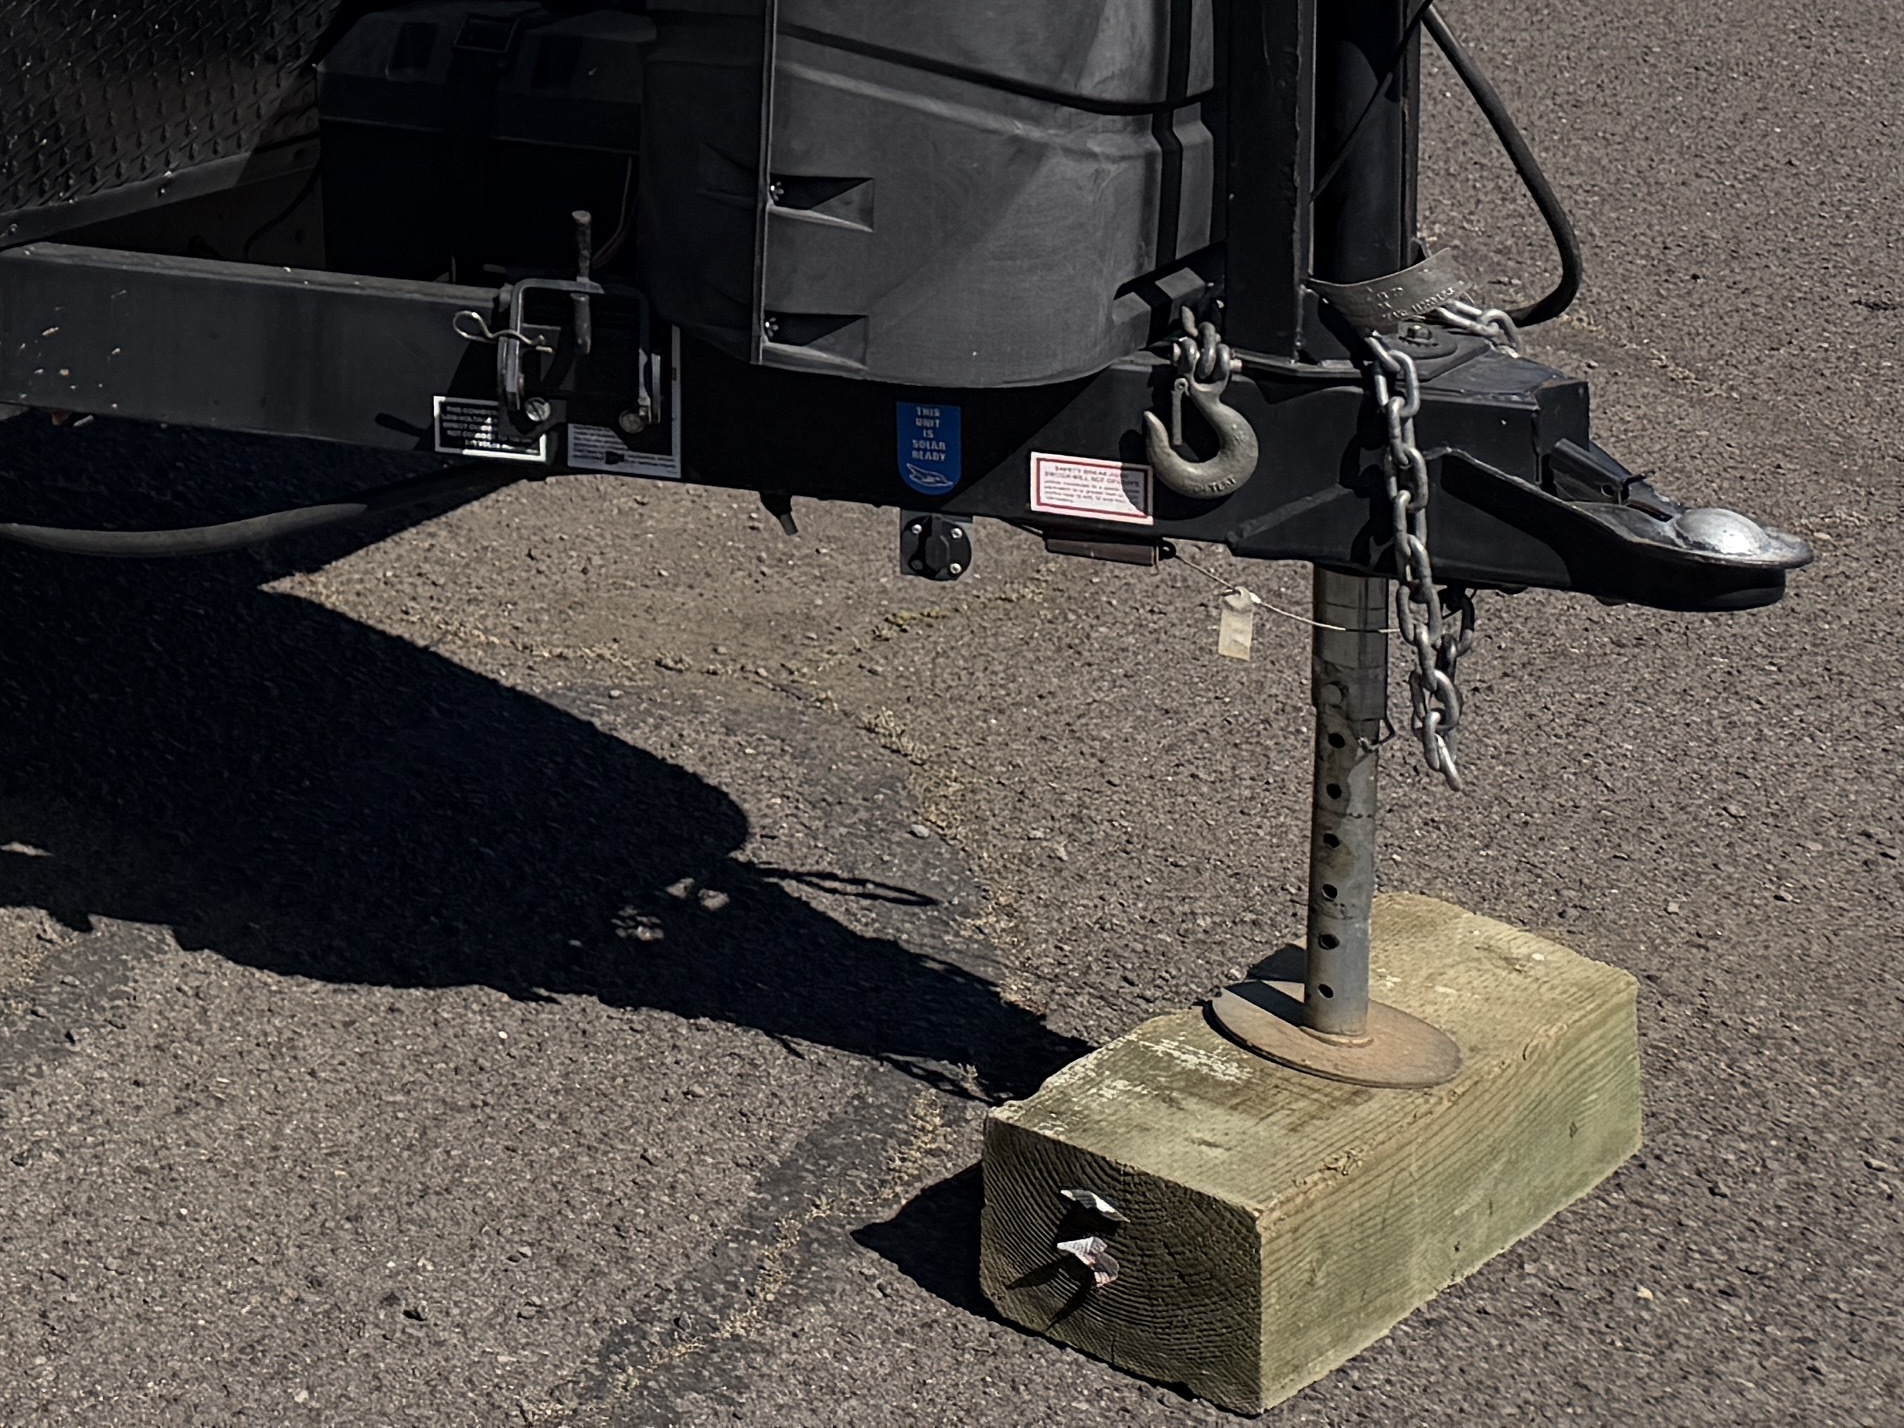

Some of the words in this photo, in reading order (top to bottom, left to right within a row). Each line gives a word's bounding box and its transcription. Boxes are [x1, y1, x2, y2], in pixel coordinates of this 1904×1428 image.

[915, 406, 940, 417] THIS
[915, 417, 940, 428] UNIT
[922, 428, 934, 438] IS
[912, 439, 946, 451] SOLAR
[911, 450, 946, 462] READY
